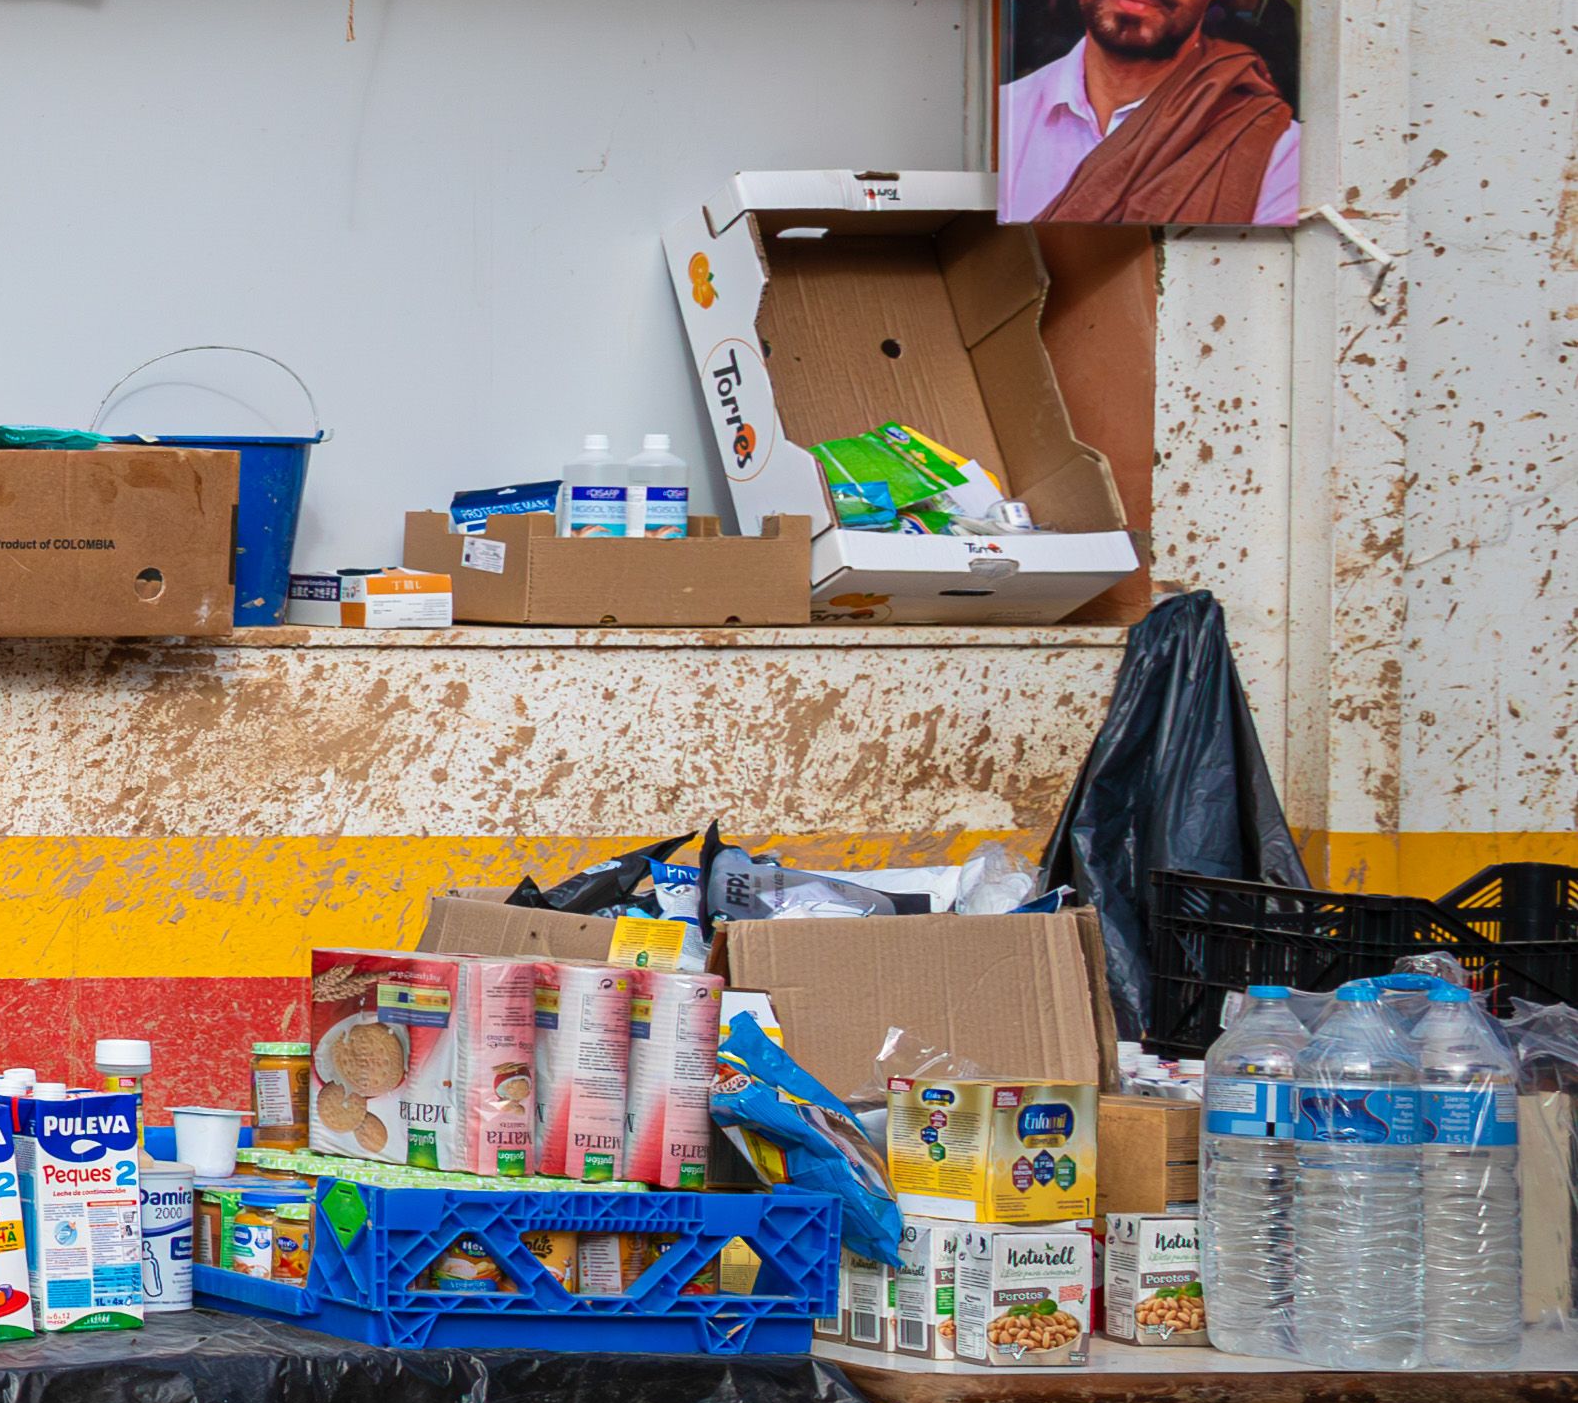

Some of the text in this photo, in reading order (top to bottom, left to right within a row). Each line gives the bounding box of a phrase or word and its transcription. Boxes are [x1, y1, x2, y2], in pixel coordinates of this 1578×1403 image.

[863, 185, 900, 200] Torres
[712, 348, 757, 471] Torres
[460, 499, 550, 520] PROTECTIVE MASK
[39, 538, 51, 550] of
[53, 538, 116, 550] COLOMBIA
[399, 1100, 452, 1128] María
[1024, 1112, 1067, 1130] Enfamil
[44, 1115, 131, 1137] PULEVA
[497, 1151, 526, 1163] gullón
[585, 1154, 614, 1166] gullón
[42, 1160, 137, 1187] Peques 2
[155, 1207, 182, 1219] 2000
[1156, 1233, 1201, 1251] Natur
[1008, 1246, 1075, 1267] Naturell
[1146, 1273, 1191, 1284] Porotos
[94, 1298, 106, 1307] 1L
[999, 1291, 1044, 1302] Porotos
